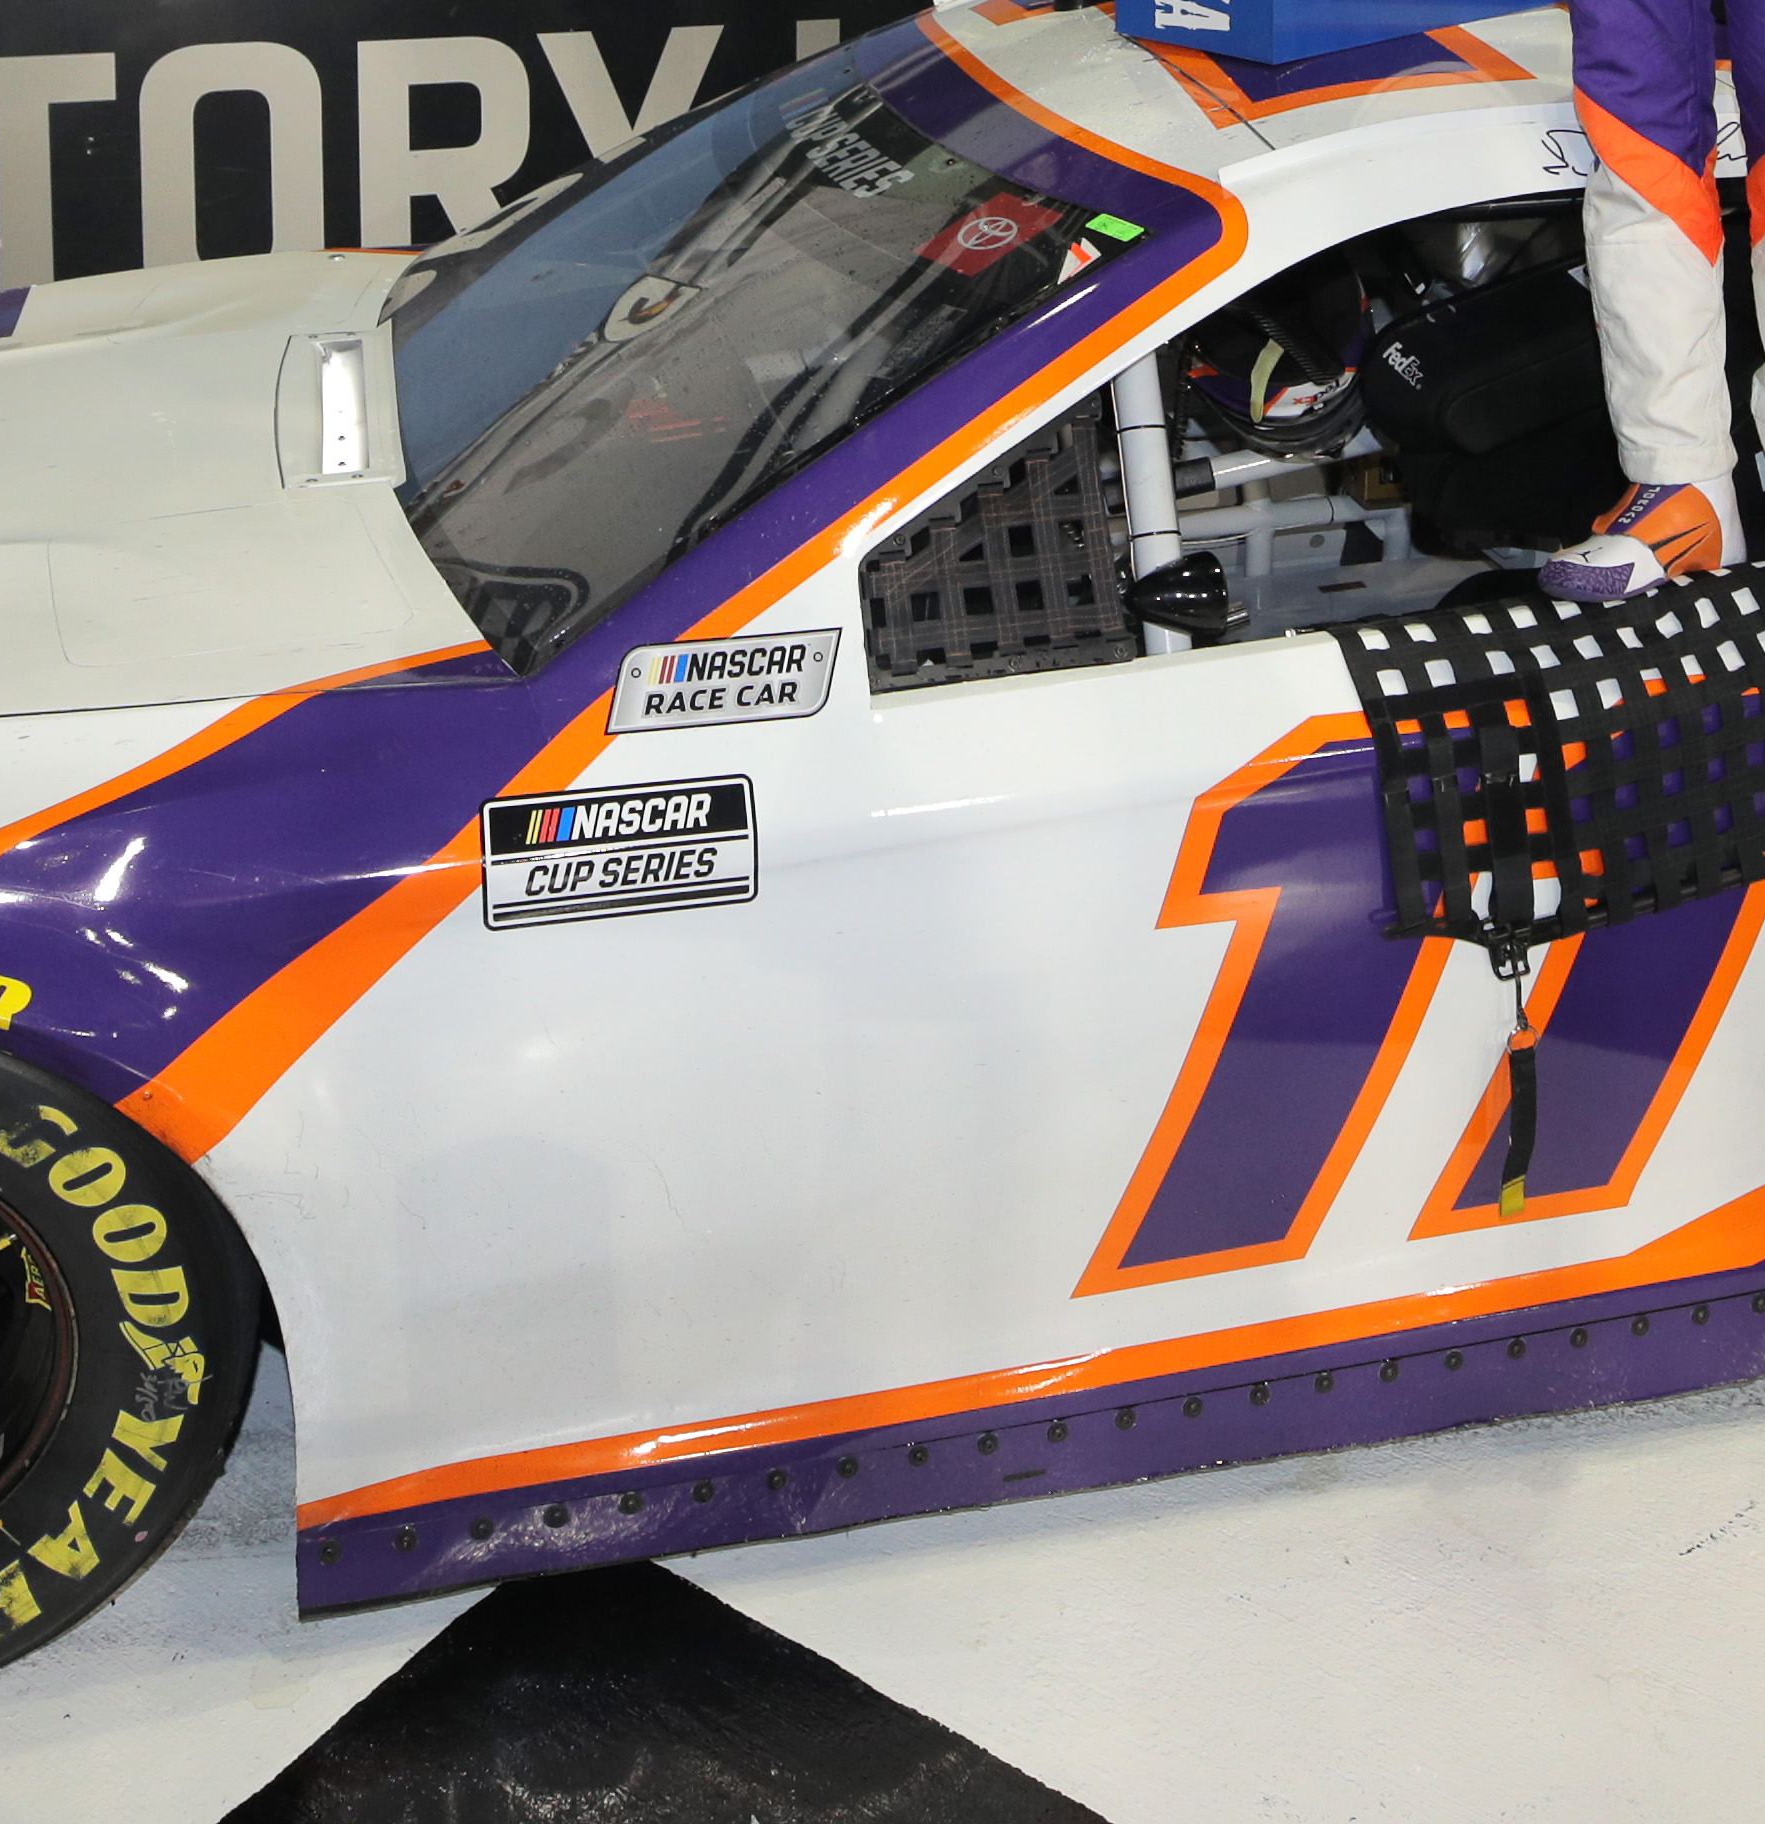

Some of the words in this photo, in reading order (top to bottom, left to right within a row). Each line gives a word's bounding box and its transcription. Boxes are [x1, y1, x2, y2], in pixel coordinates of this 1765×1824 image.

[811, 121, 914, 198] SERIES
[1382, 342, 1422, 388] FedEx
[686, 645, 805, 680] NASCAR
[645, 688, 724, 715] RACE
[737, 683, 798, 707] CAR
[571, 794, 711, 839] NASCAR
[526, 863, 593, 896] CUP
[599, 848, 716, 888] SERIES
